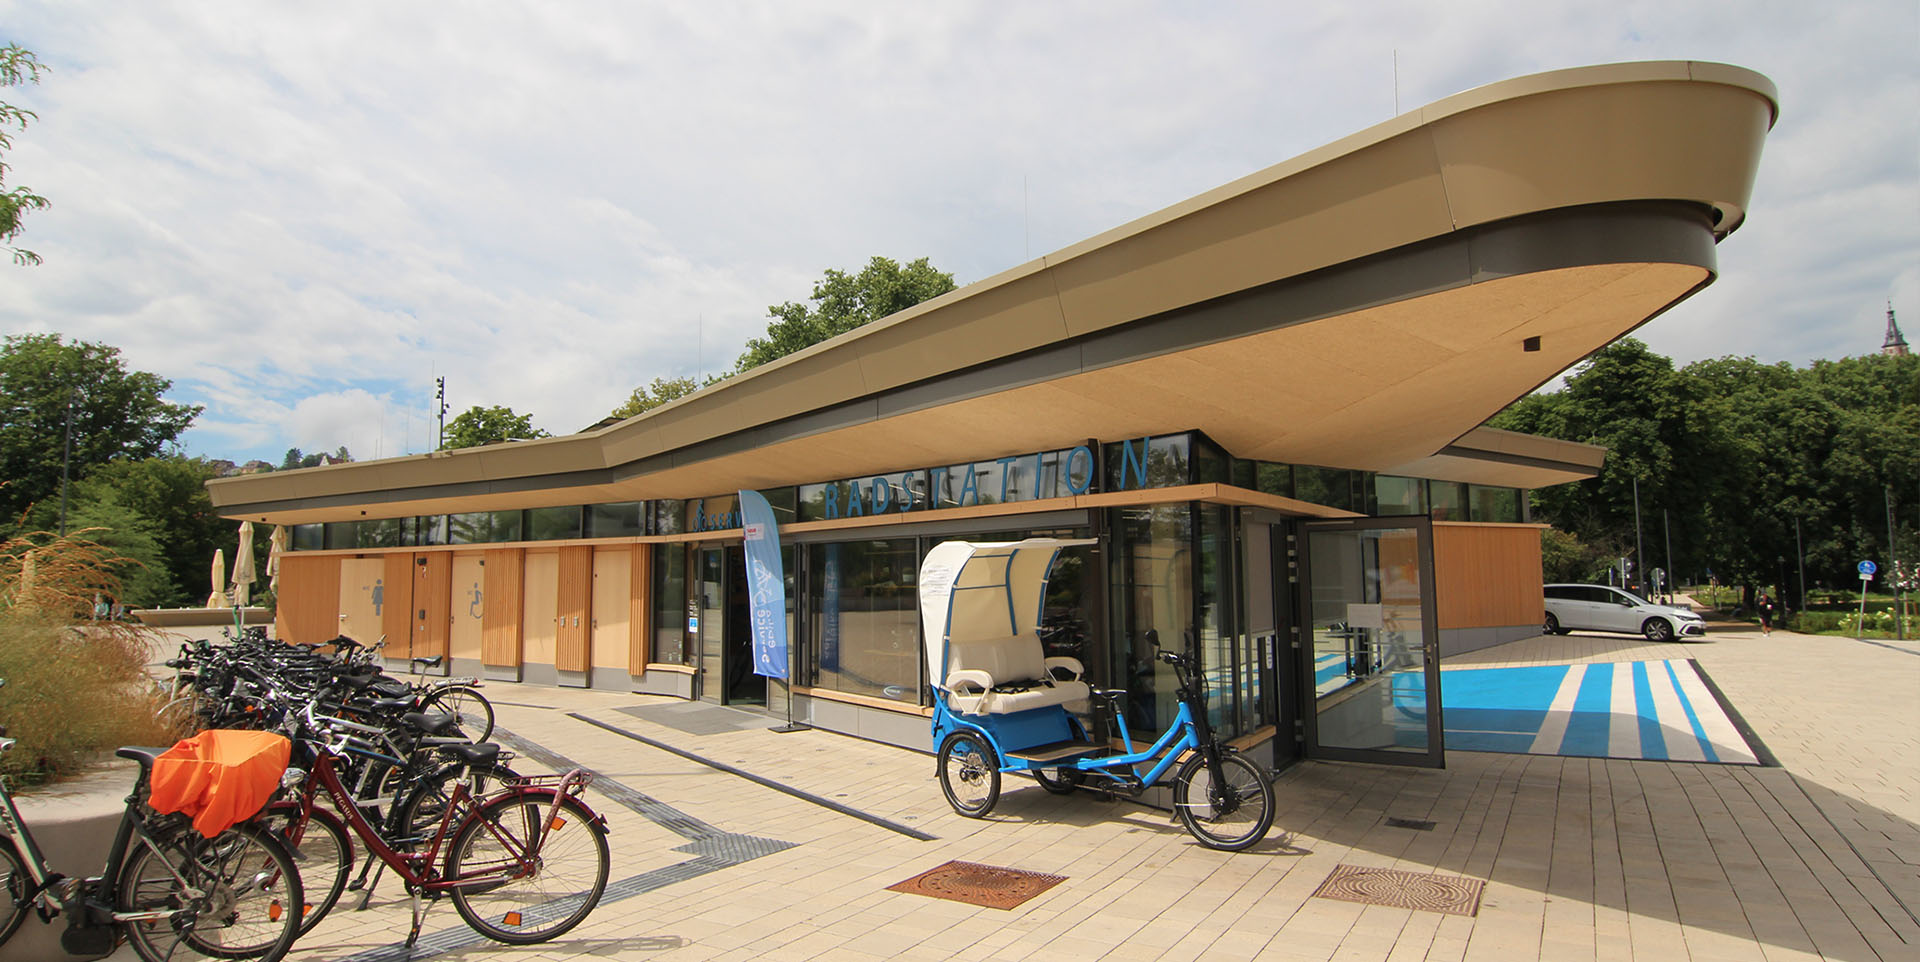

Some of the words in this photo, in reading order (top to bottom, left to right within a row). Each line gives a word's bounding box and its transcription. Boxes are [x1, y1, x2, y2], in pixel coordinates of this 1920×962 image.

[823, 437, 1152, 520] RADSTATION
[709, 512, 742, 531] SERV
[334, 792, 354, 820] PEGASUS
